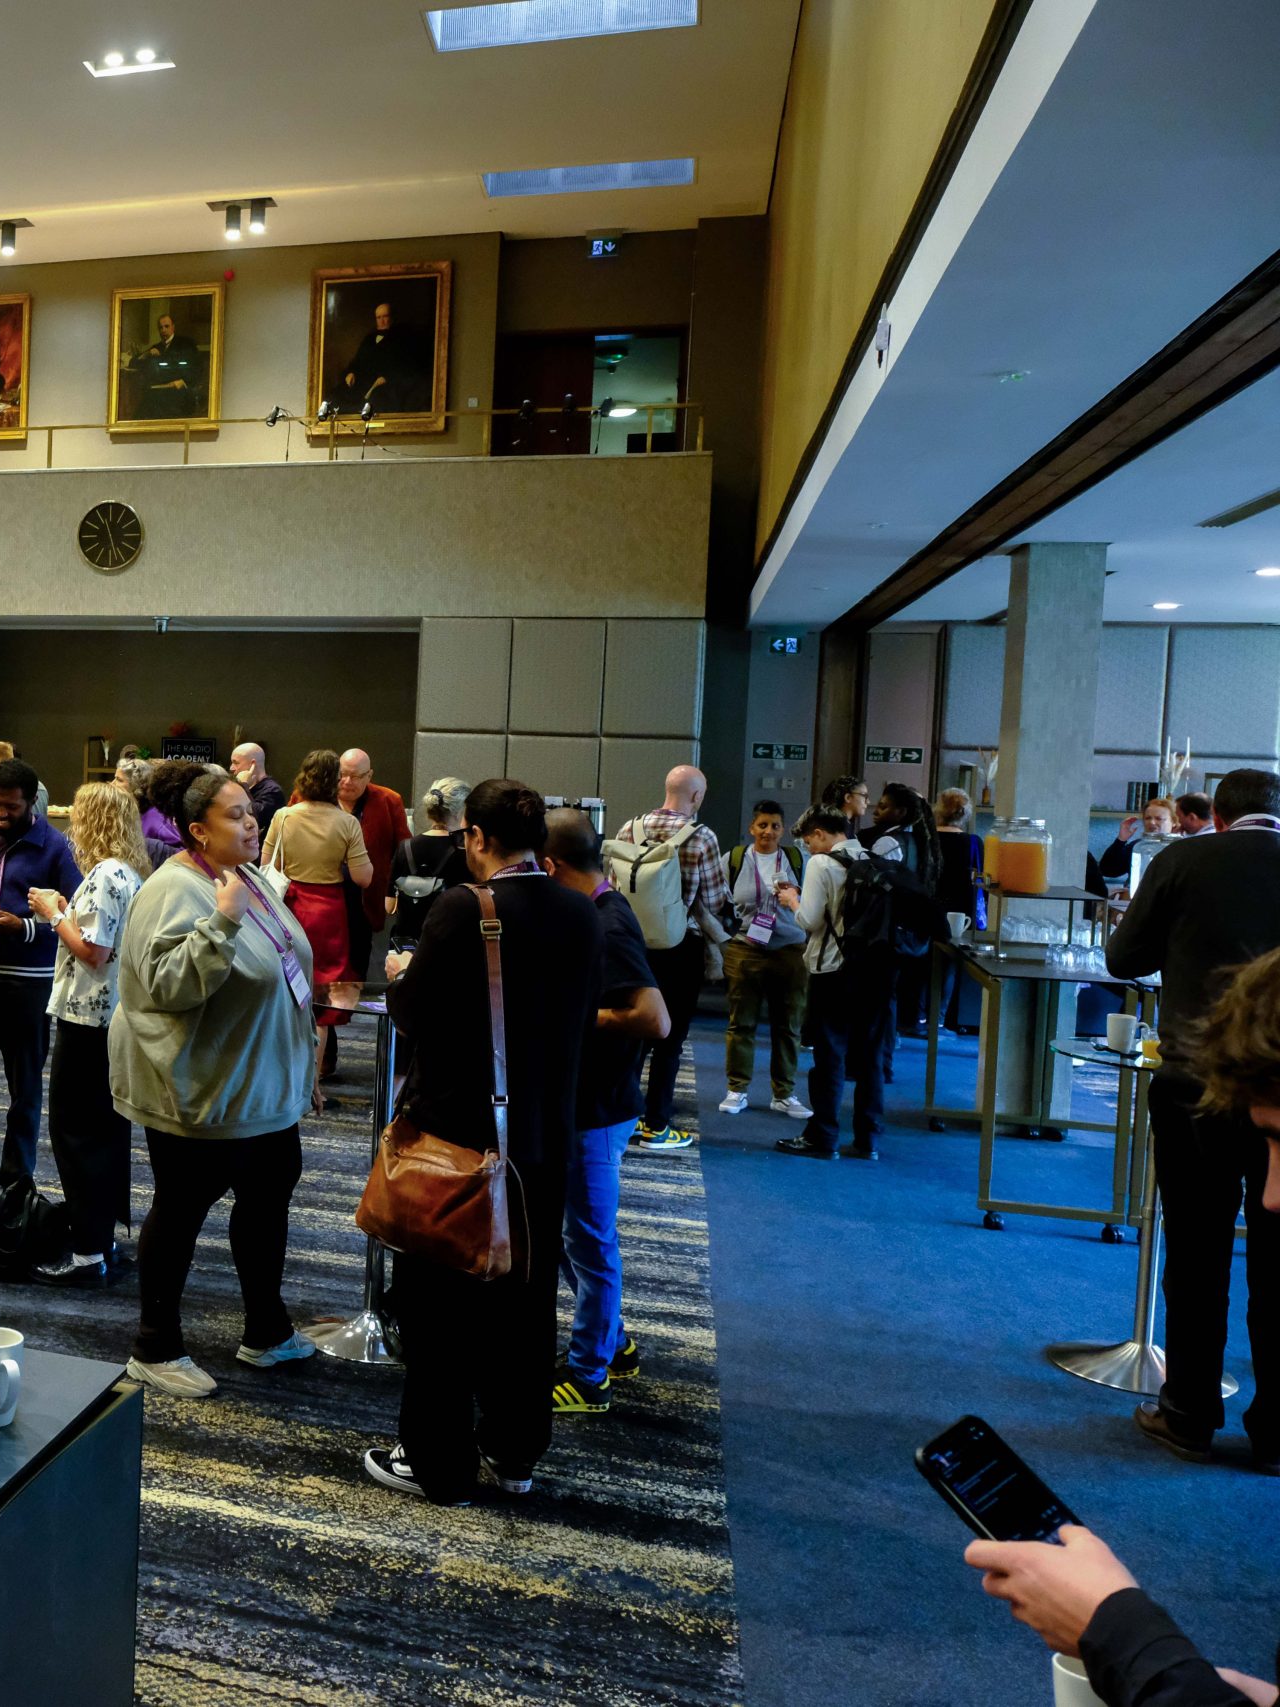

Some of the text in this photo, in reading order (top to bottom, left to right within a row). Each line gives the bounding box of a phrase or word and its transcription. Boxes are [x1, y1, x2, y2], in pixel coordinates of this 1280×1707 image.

[167, 744, 211, 753] THE RADIO
[167, 754, 211, 763] ACADEMY
